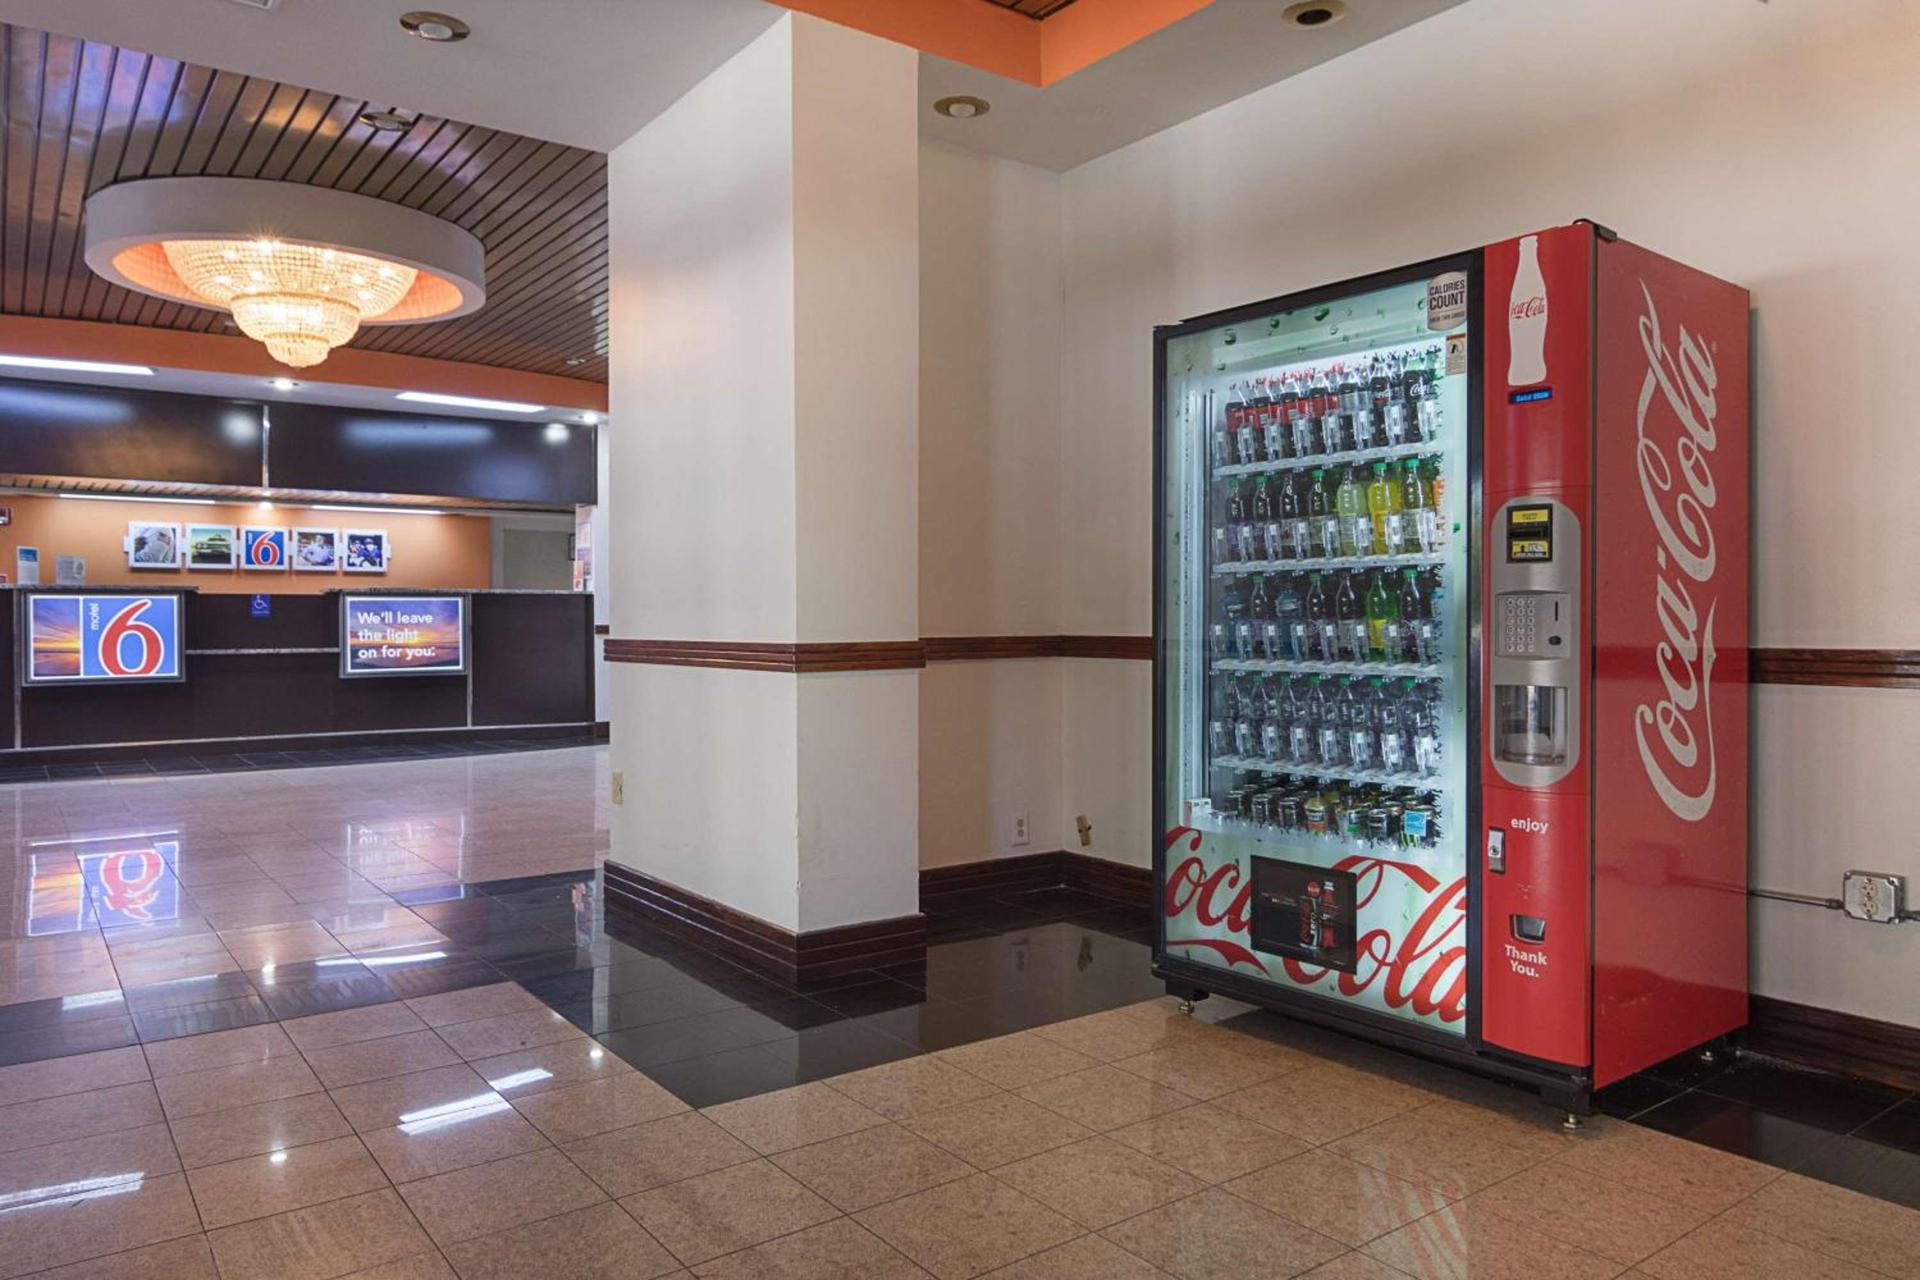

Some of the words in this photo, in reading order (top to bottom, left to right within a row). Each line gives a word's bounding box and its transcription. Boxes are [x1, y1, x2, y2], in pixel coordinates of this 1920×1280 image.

[1429, 279, 1465, 297] CALORIES
[1429, 291, 1465, 311] COUNT
[251, 530, 280, 566] 6
[1635, 278, 1718, 822] Coca-Cola
[89, 602, 101, 631] motel
[357, 611, 393, 624] We'll
[397, 611, 433, 624] leave
[98, 598, 165, 675] 6
[358, 629, 382, 642] the
[386, 628, 419, 644] light
[358, 649, 377, 659] on
[380, 645, 402, 658] for
[1511, 818, 1549, 834] enjoy
[1504, 944, 1548, 966] Thank
[1510, 960, 1541, 978] You.
